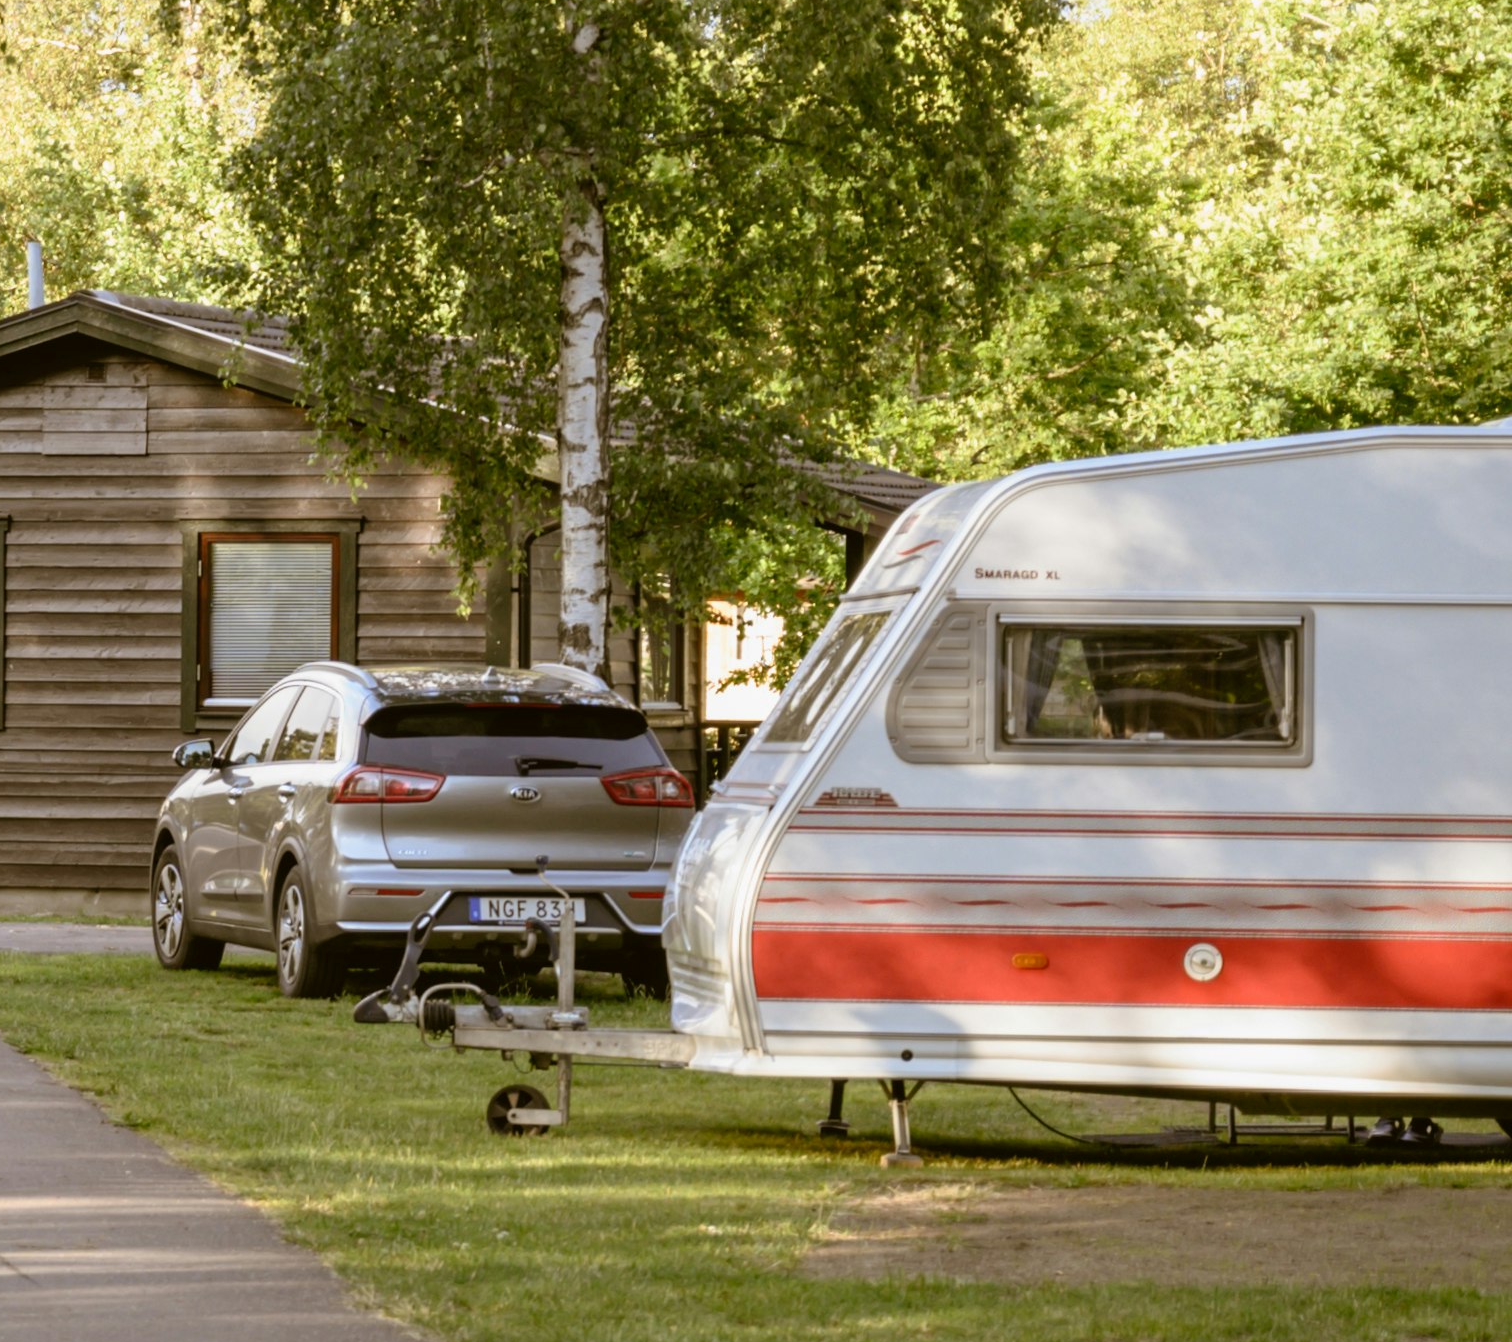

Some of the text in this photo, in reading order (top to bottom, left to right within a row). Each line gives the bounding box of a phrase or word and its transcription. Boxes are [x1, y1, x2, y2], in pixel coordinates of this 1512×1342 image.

[1046, 570, 1061, 579] XL
[515, 789, 536, 799] KIA
[489, 900, 526, 917] NGF
